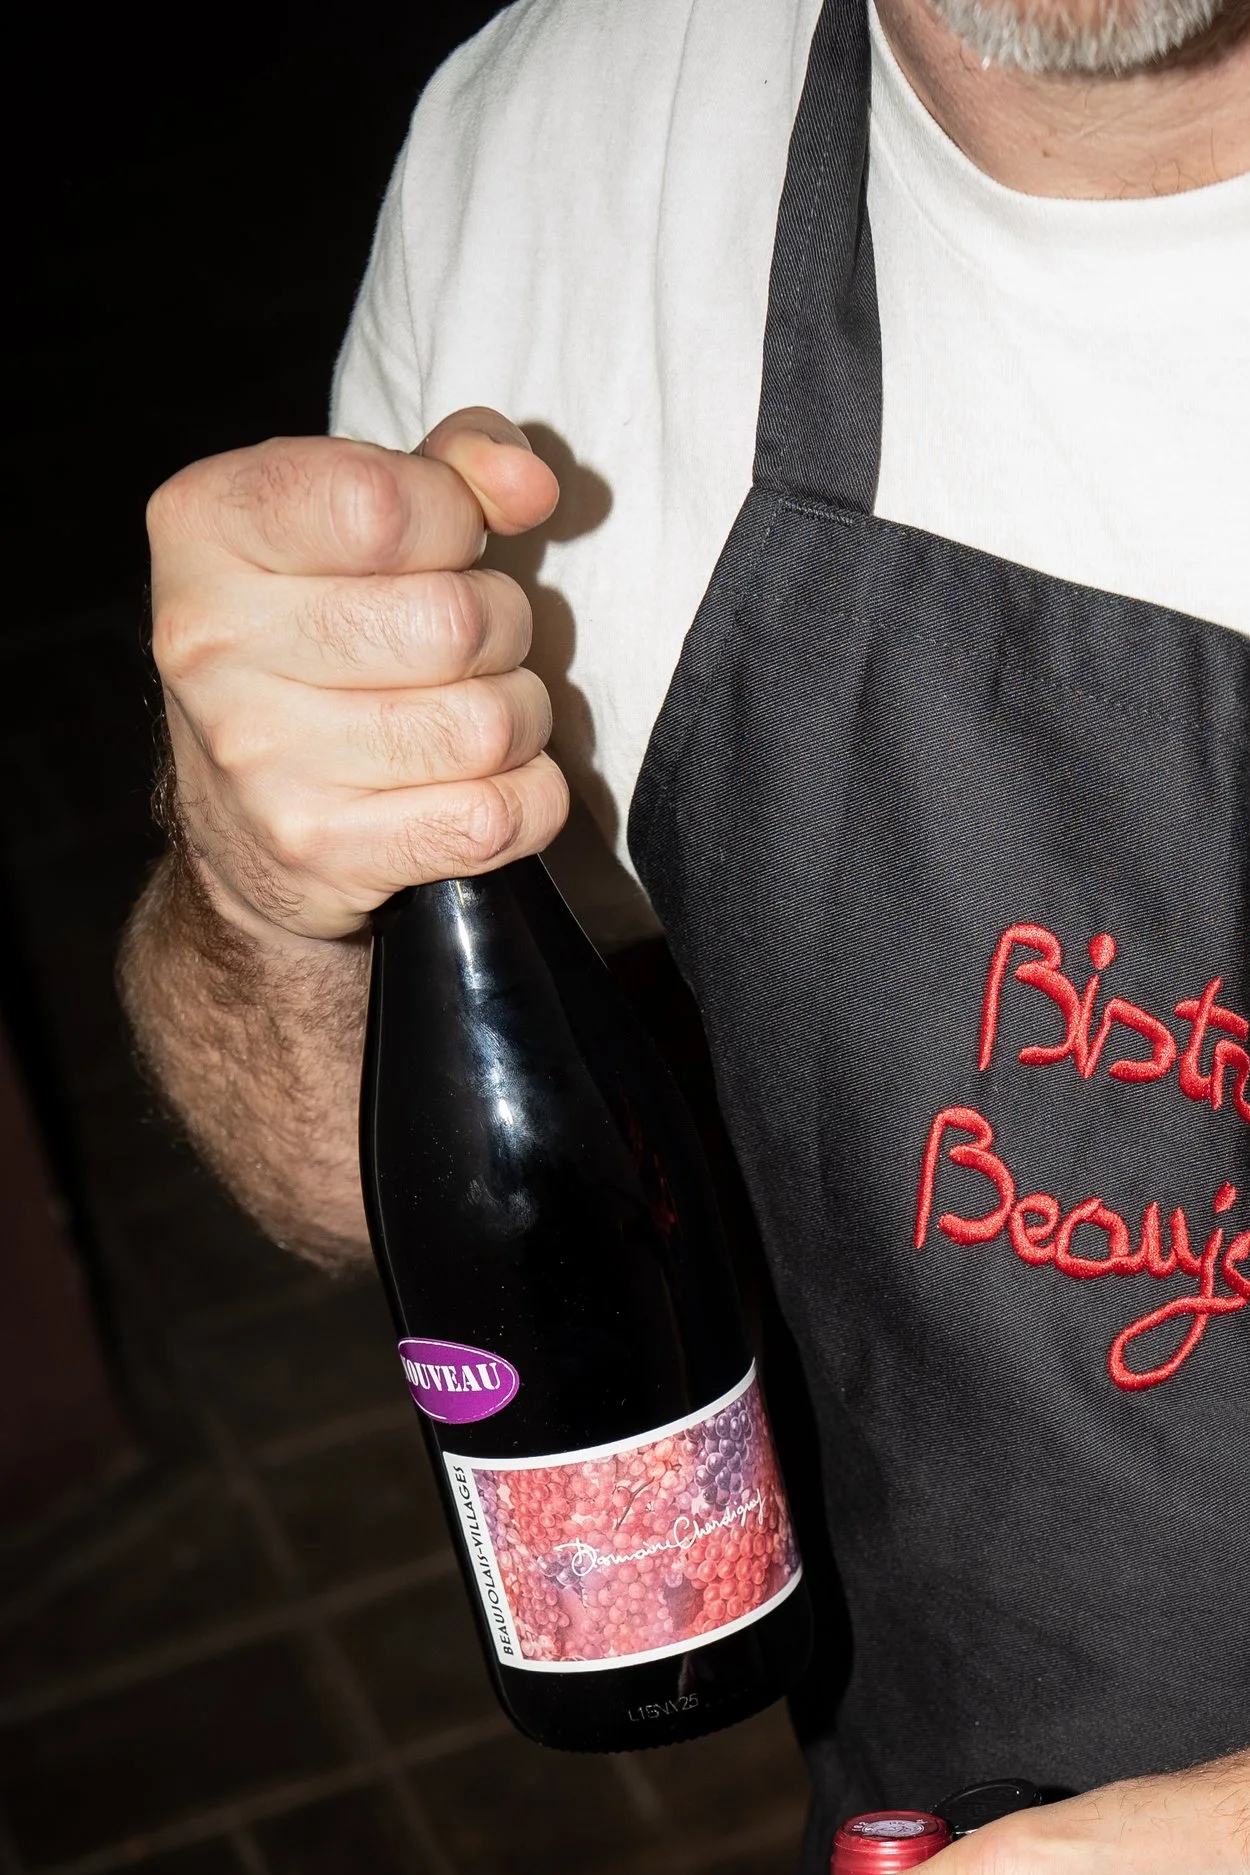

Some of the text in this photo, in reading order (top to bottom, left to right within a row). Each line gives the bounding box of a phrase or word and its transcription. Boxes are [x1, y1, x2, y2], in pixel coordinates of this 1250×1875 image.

[453, 1466, 514, 1656] BEAUJOLAIS-VILLAGES
[553, 1488, 766, 1577] Domaine Chardigny
